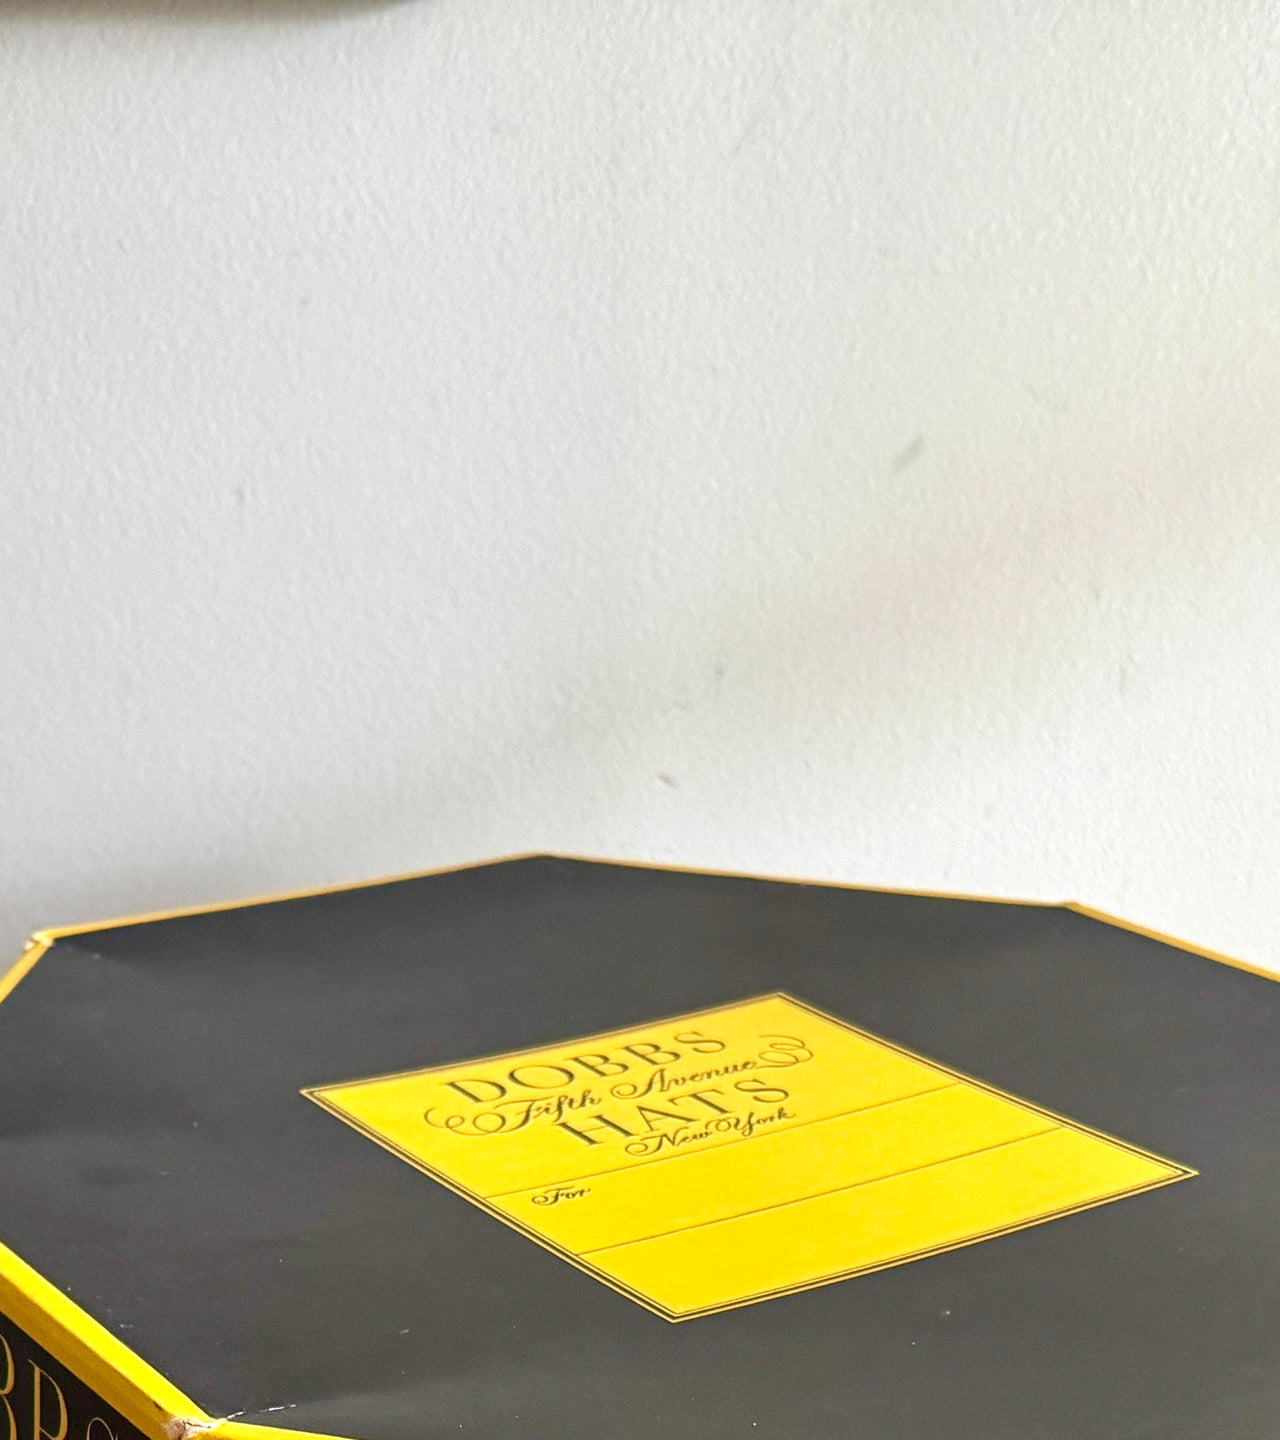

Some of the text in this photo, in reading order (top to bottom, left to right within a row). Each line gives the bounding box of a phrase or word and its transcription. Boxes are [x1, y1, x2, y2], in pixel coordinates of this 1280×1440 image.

[424, 1034, 814, 1136] Fifth Avenue
[444, 1031, 726, 1104] DOBBS
[555, 1077, 790, 1146] HATS
[625, 1107, 796, 1156] New York
[531, 1186, 592, 1207] For
